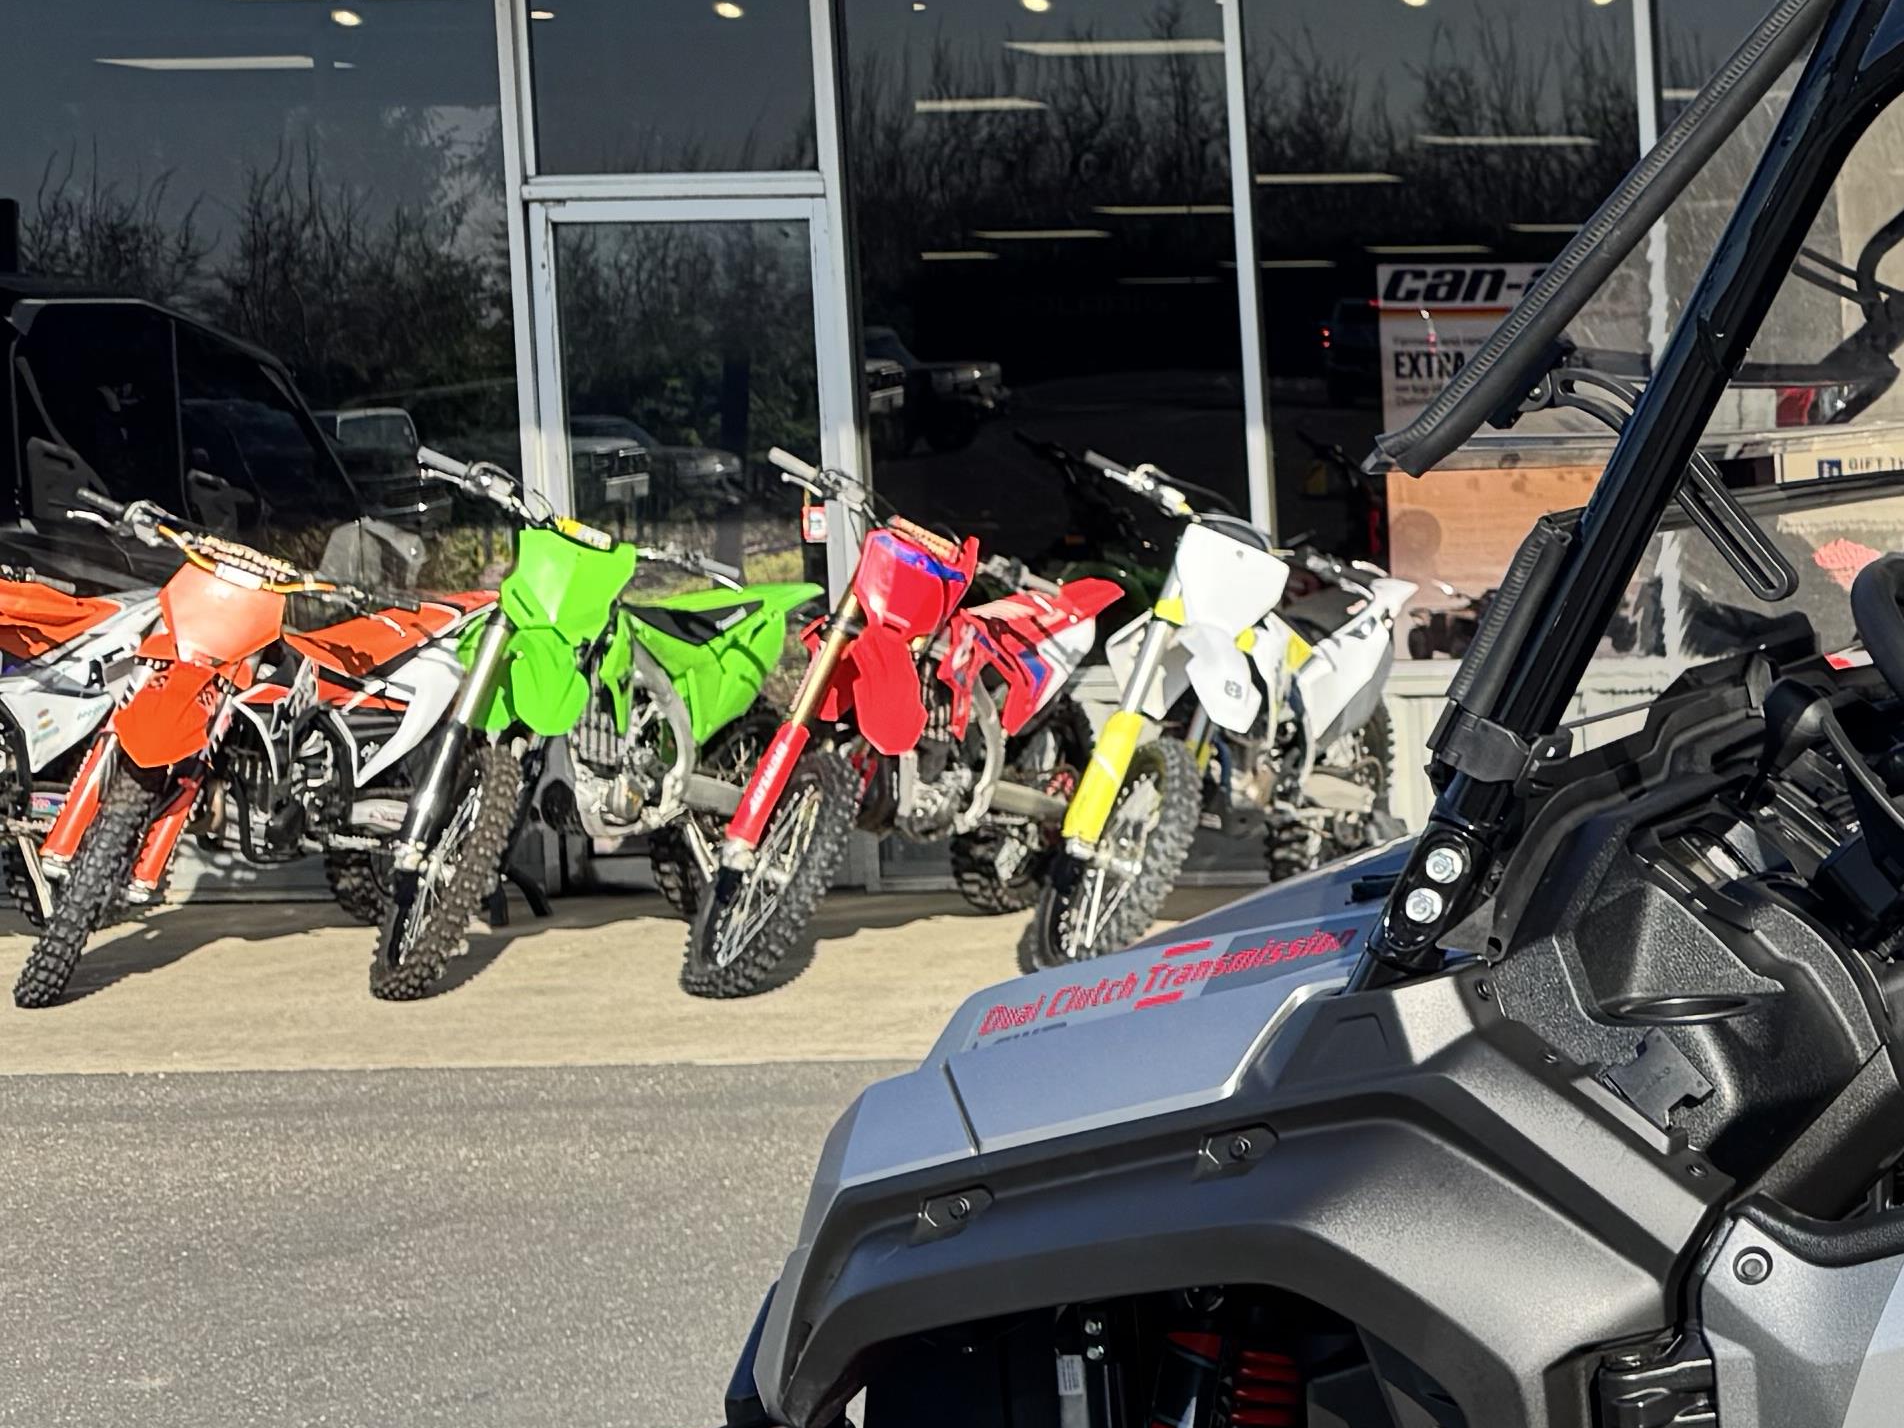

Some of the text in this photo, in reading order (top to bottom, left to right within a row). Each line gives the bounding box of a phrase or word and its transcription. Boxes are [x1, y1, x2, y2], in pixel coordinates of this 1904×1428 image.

[1394, 351, 1465, 378] EXTRA
[979, 928, 1358, 1036] Dual Clutch Transmission
